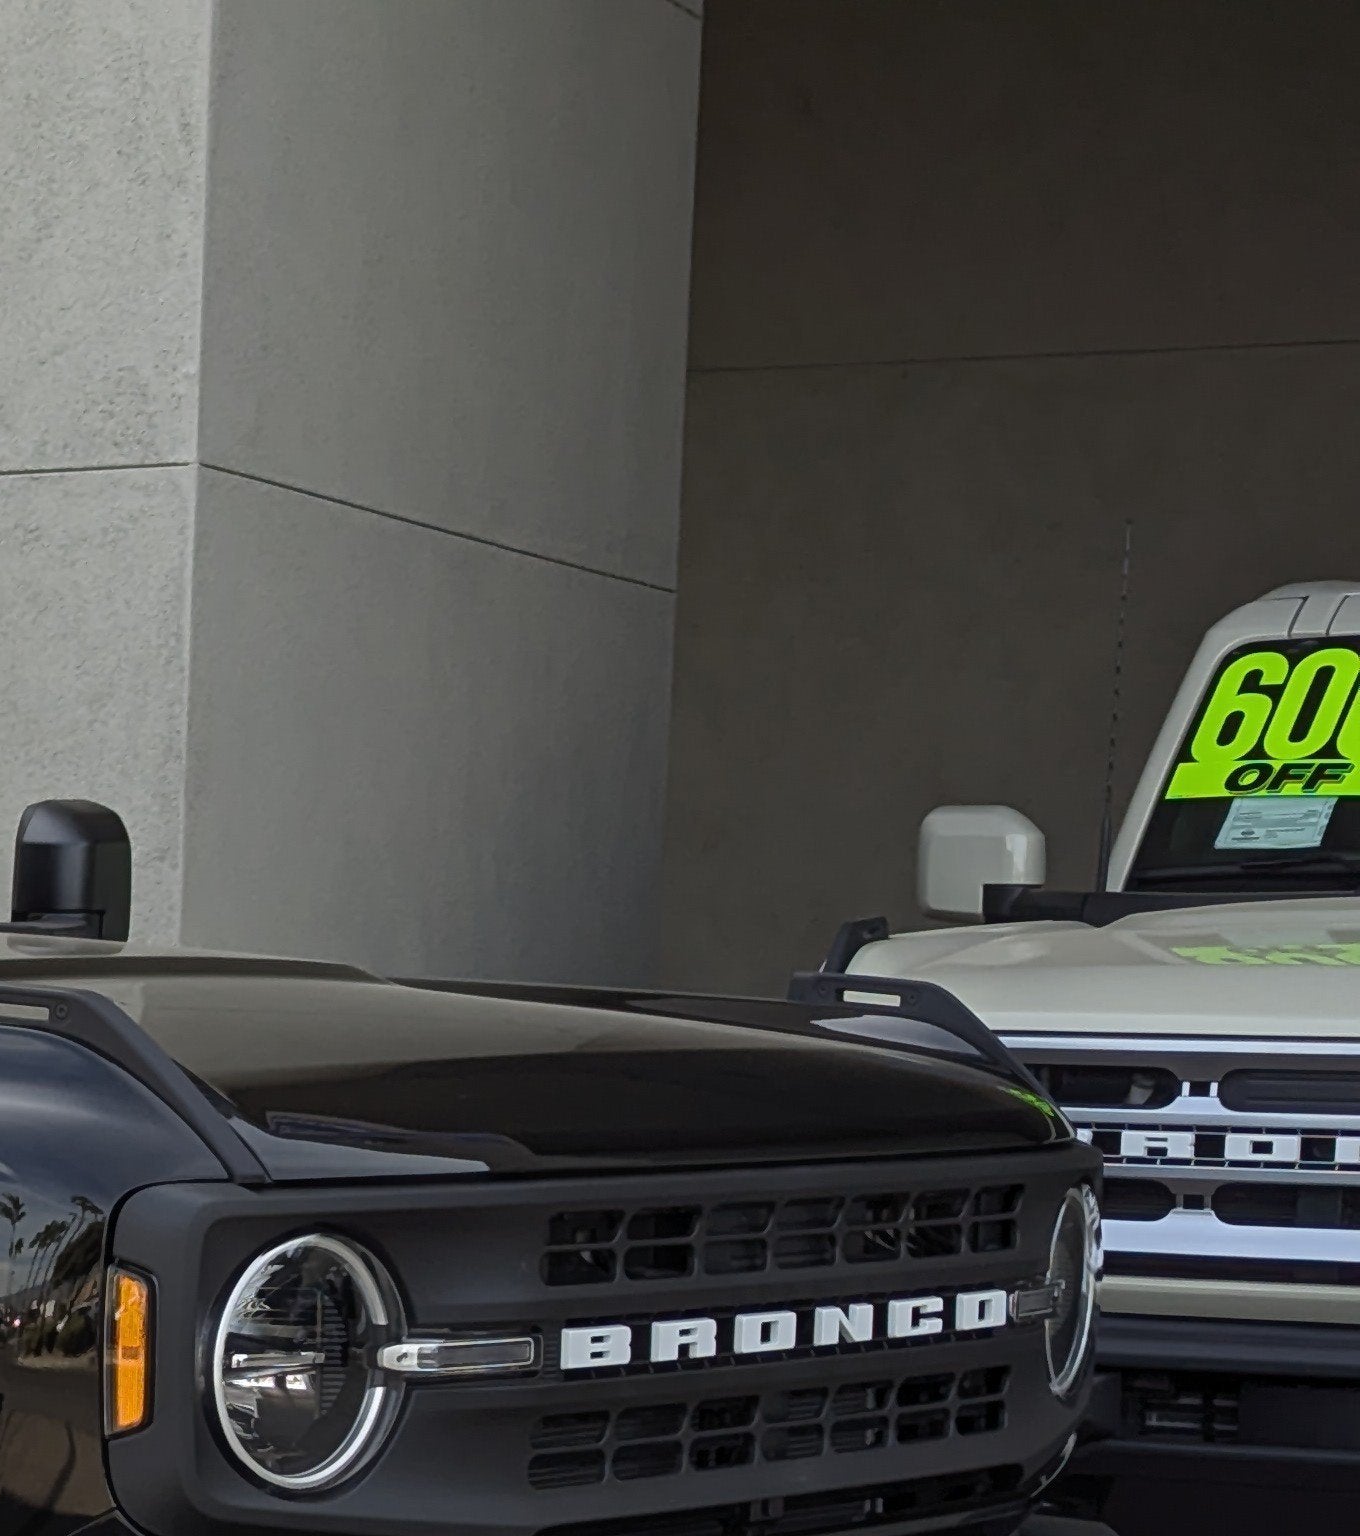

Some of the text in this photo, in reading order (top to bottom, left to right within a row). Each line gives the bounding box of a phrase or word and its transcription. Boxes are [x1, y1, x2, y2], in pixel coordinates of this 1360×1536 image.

[1191, 647, 1360, 760] 60
[1224, 762, 1355, 794] OFF
[1077, 1128, 1360, 1164] RO
[560, 1289, 1008, 1370] BRONCO
